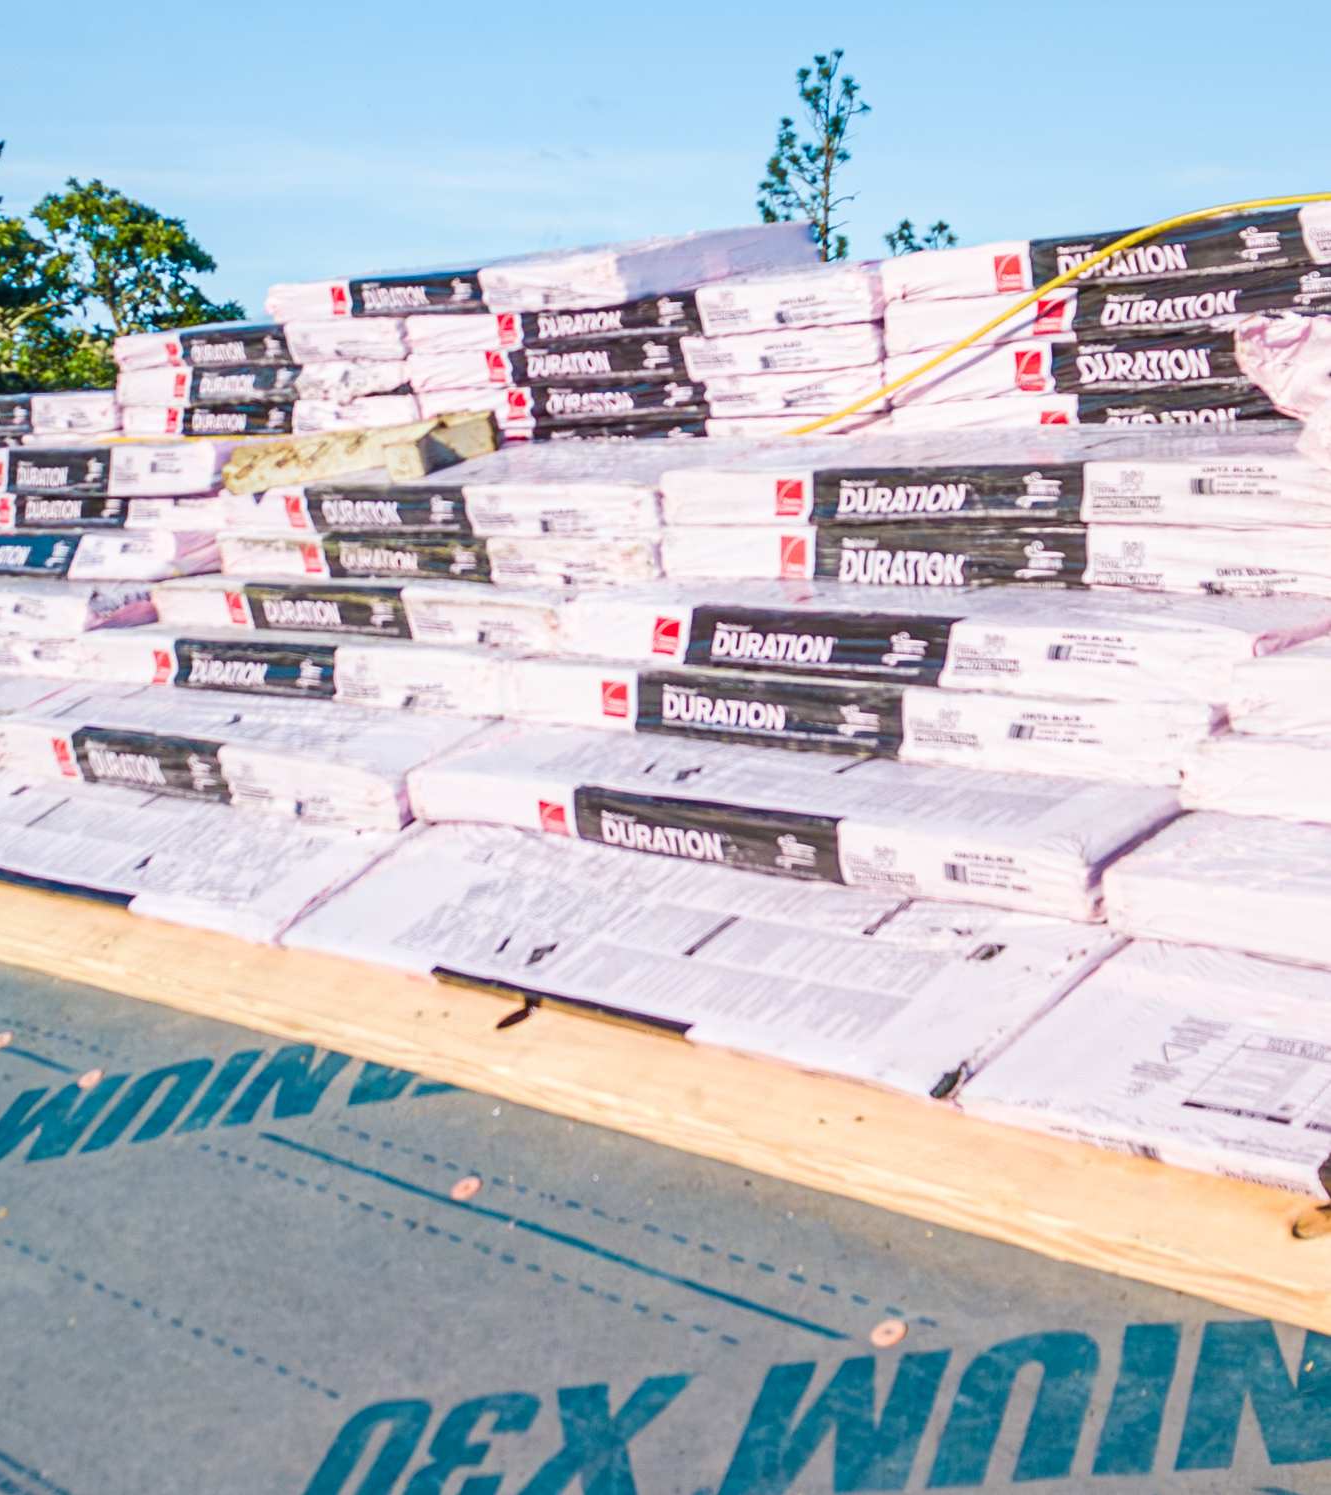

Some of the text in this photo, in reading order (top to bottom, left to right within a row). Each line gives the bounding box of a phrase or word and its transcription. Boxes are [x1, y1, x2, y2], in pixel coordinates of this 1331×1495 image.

[538, 310, 623, 338] DURATION
[1101, 289, 1239, 327] DURATION
[527, 350, 611, 378] DURATION
[1076, 348, 1211, 385] DURATION
[322, 500, 402, 526] DURATION
[838, 484, 967, 514] DURATION
[839, 550, 966, 586] DURATION
[262, 599, 342, 625] DURATION
[711, 630, 834, 664] DURATION
[188, 659, 269, 687] DURATION
[662, 691, 786, 731] DURATION
[87, 749, 168, 785] DURATION
[601, 816, 725, 862] DURATION
[302, 1371, 700, 1495] X30
